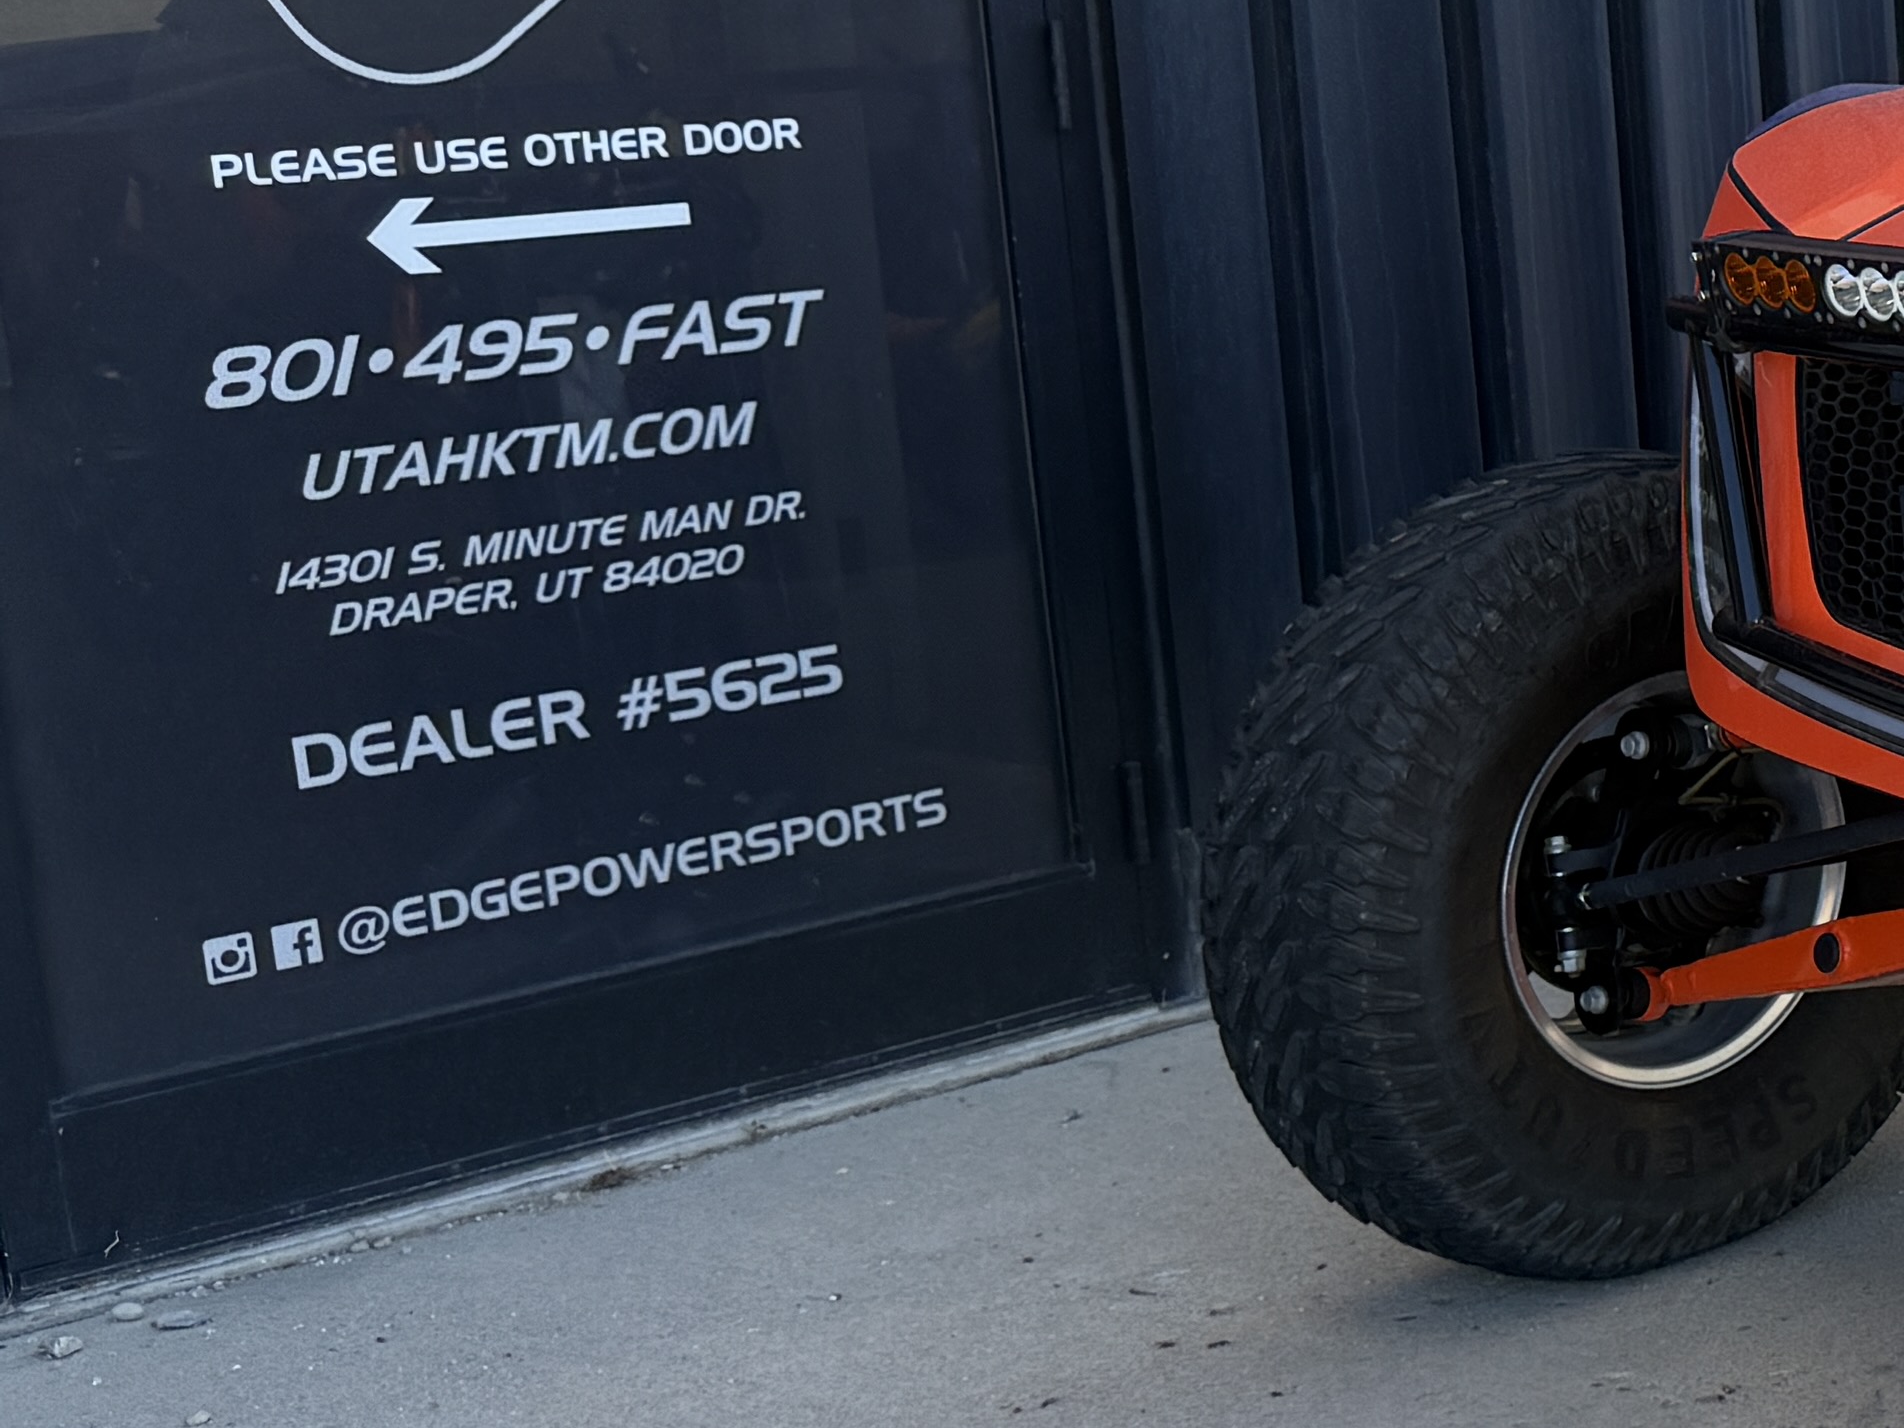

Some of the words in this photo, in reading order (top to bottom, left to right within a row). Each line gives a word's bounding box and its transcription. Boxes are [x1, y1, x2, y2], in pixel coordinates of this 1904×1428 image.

[210, 142, 398, 189] PLEASE
[413, 136, 509, 175] USE
[523, 126, 669, 167] OTHER
[682, 117, 803, 156] DOOR
[302, 401, 757, 501] UTAHKTM.COM
[275, 546, 395, 595] 14301
[407, 540, 446, 575] S.
[464, 514, 628, 567] MINUTE
[639, 498, 732, 542] MAN
[745, 490, 808, 526] DR.
[329, 578, 518, 636] DRAPER,
[536, 564, 588, 603] UT
[603, 544, 745, 593] 84020
[291, 690, 591, 790] DEALER
[616, 644, 843, 732] #5625
[338, 788, 948, 955] @EDGEPOWERSPORTS
